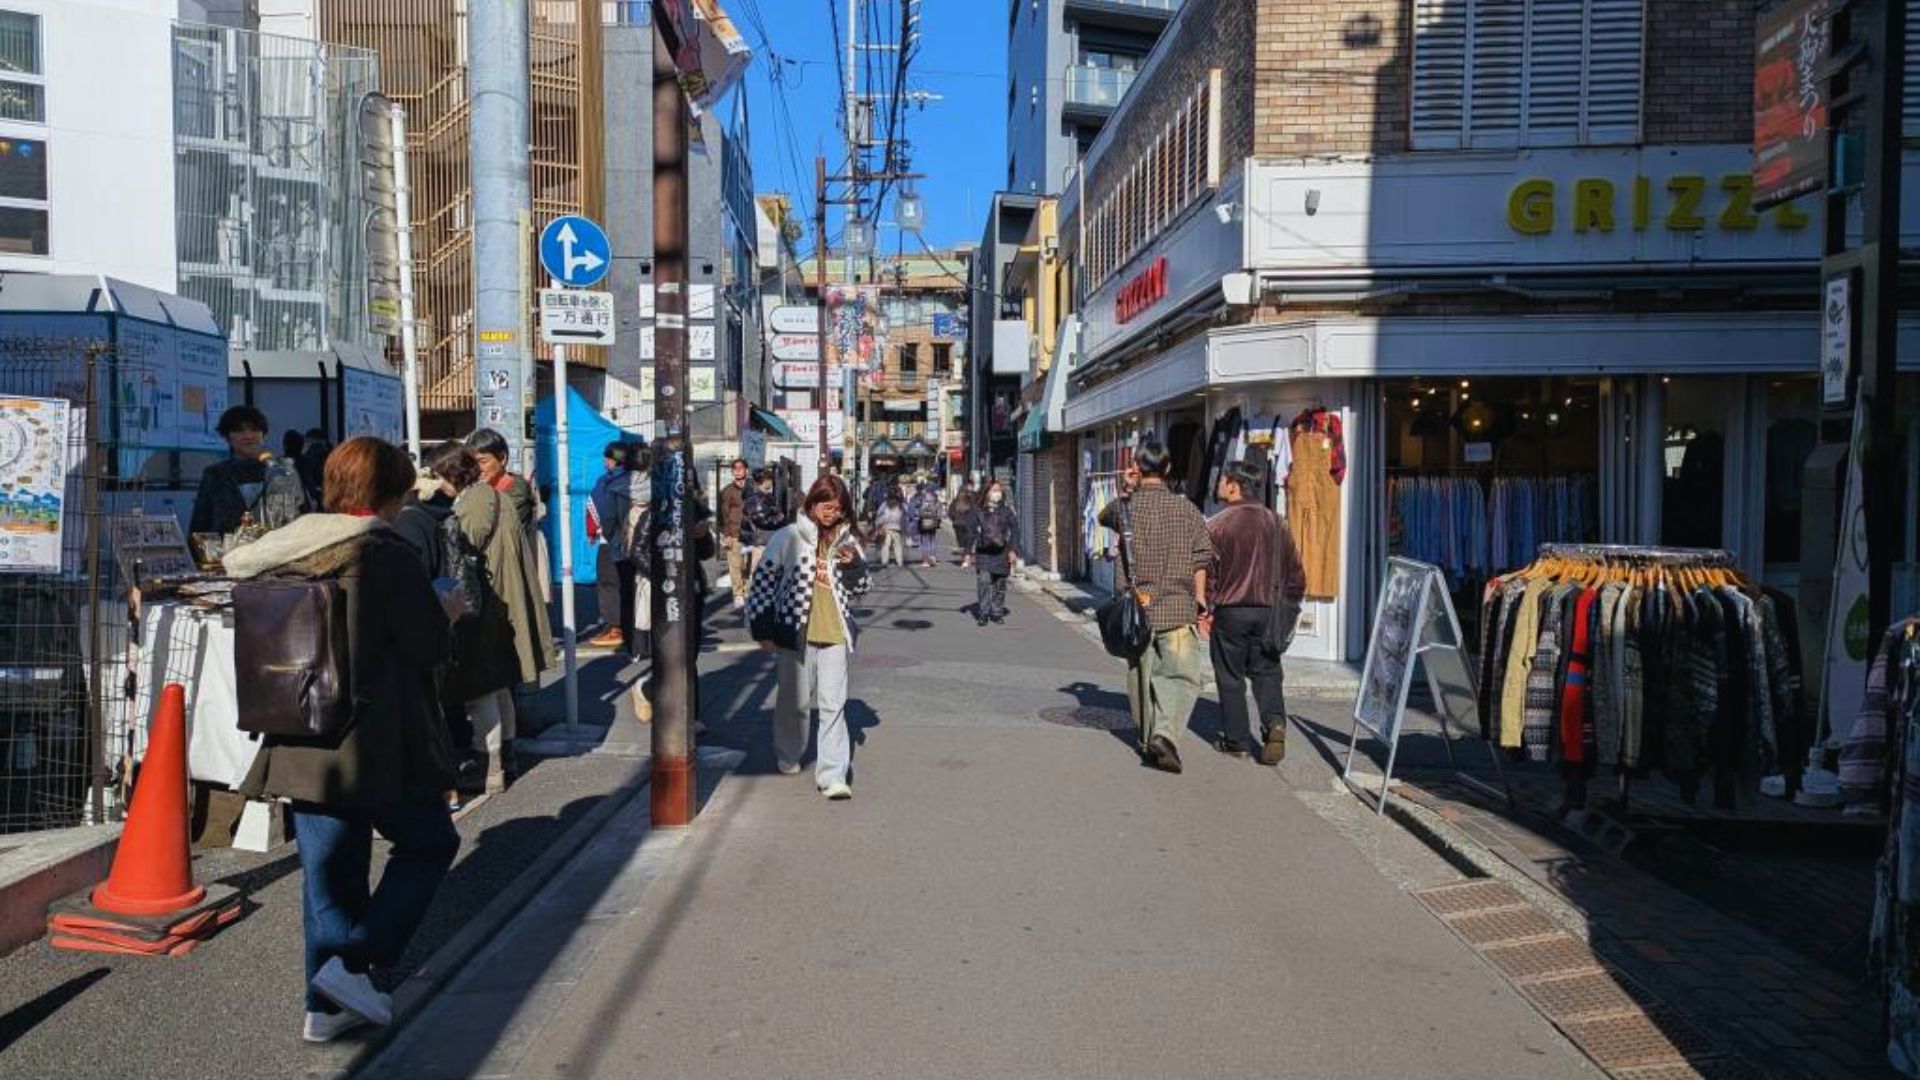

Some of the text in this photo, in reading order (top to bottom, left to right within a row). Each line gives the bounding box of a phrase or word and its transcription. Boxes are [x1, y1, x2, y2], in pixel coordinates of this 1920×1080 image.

[545, 293, 610, 308] 自転車を除く
[546, 310, 611, 326] 一方通行
